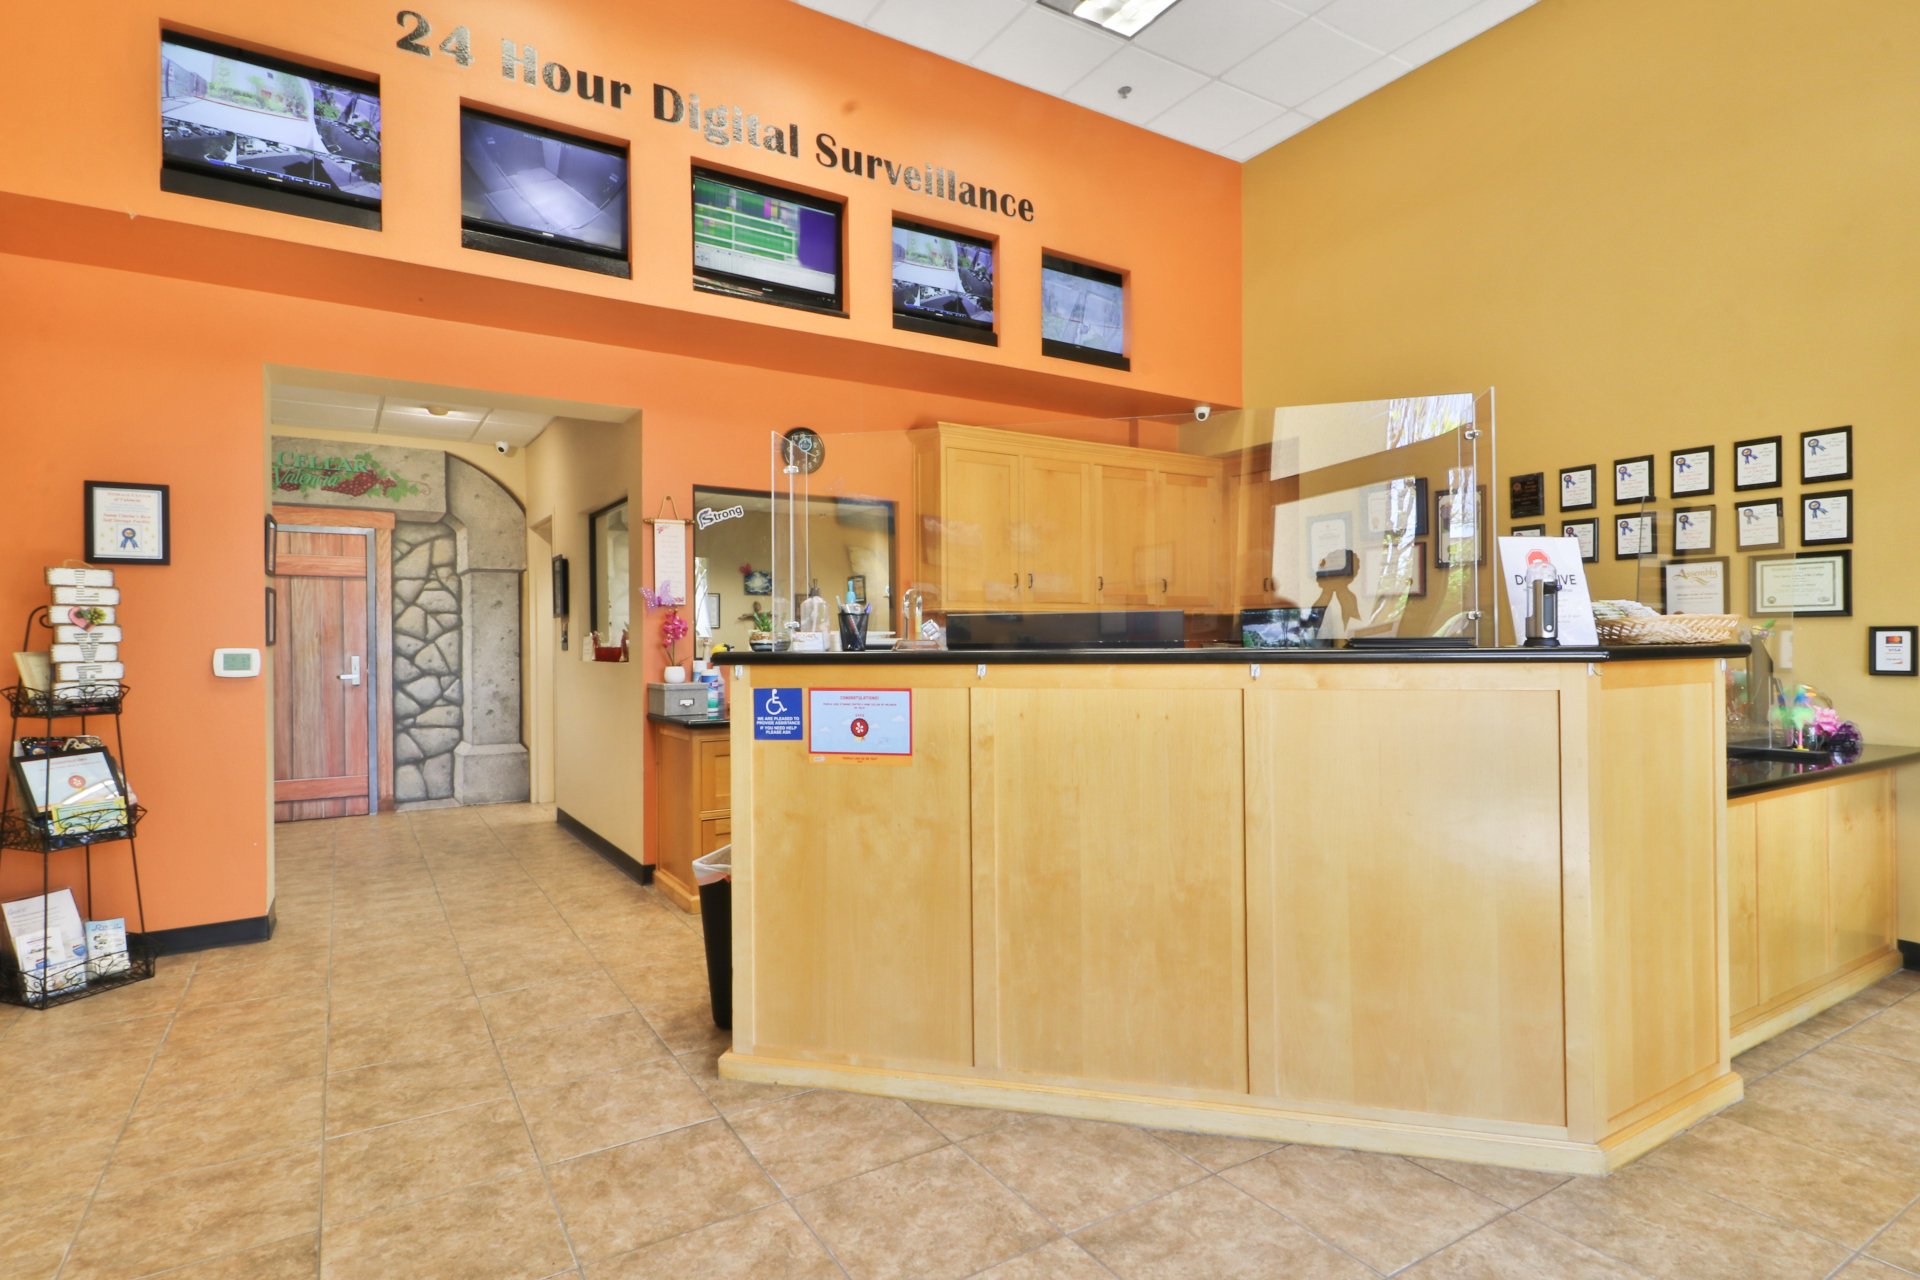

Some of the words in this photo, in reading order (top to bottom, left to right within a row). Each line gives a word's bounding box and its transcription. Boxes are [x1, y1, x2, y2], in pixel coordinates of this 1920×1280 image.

[396, 10, 474, 67] 24
[501, 38, 632, 109] Hour
[653, 83, 799, 158] Digital
[815, 133, 1034, 222] Surveillance
[277, 451, 368, 473] CELLAR
[272, 465, 341, 488] Valencia
[699, 507, 743, 528] Strong
